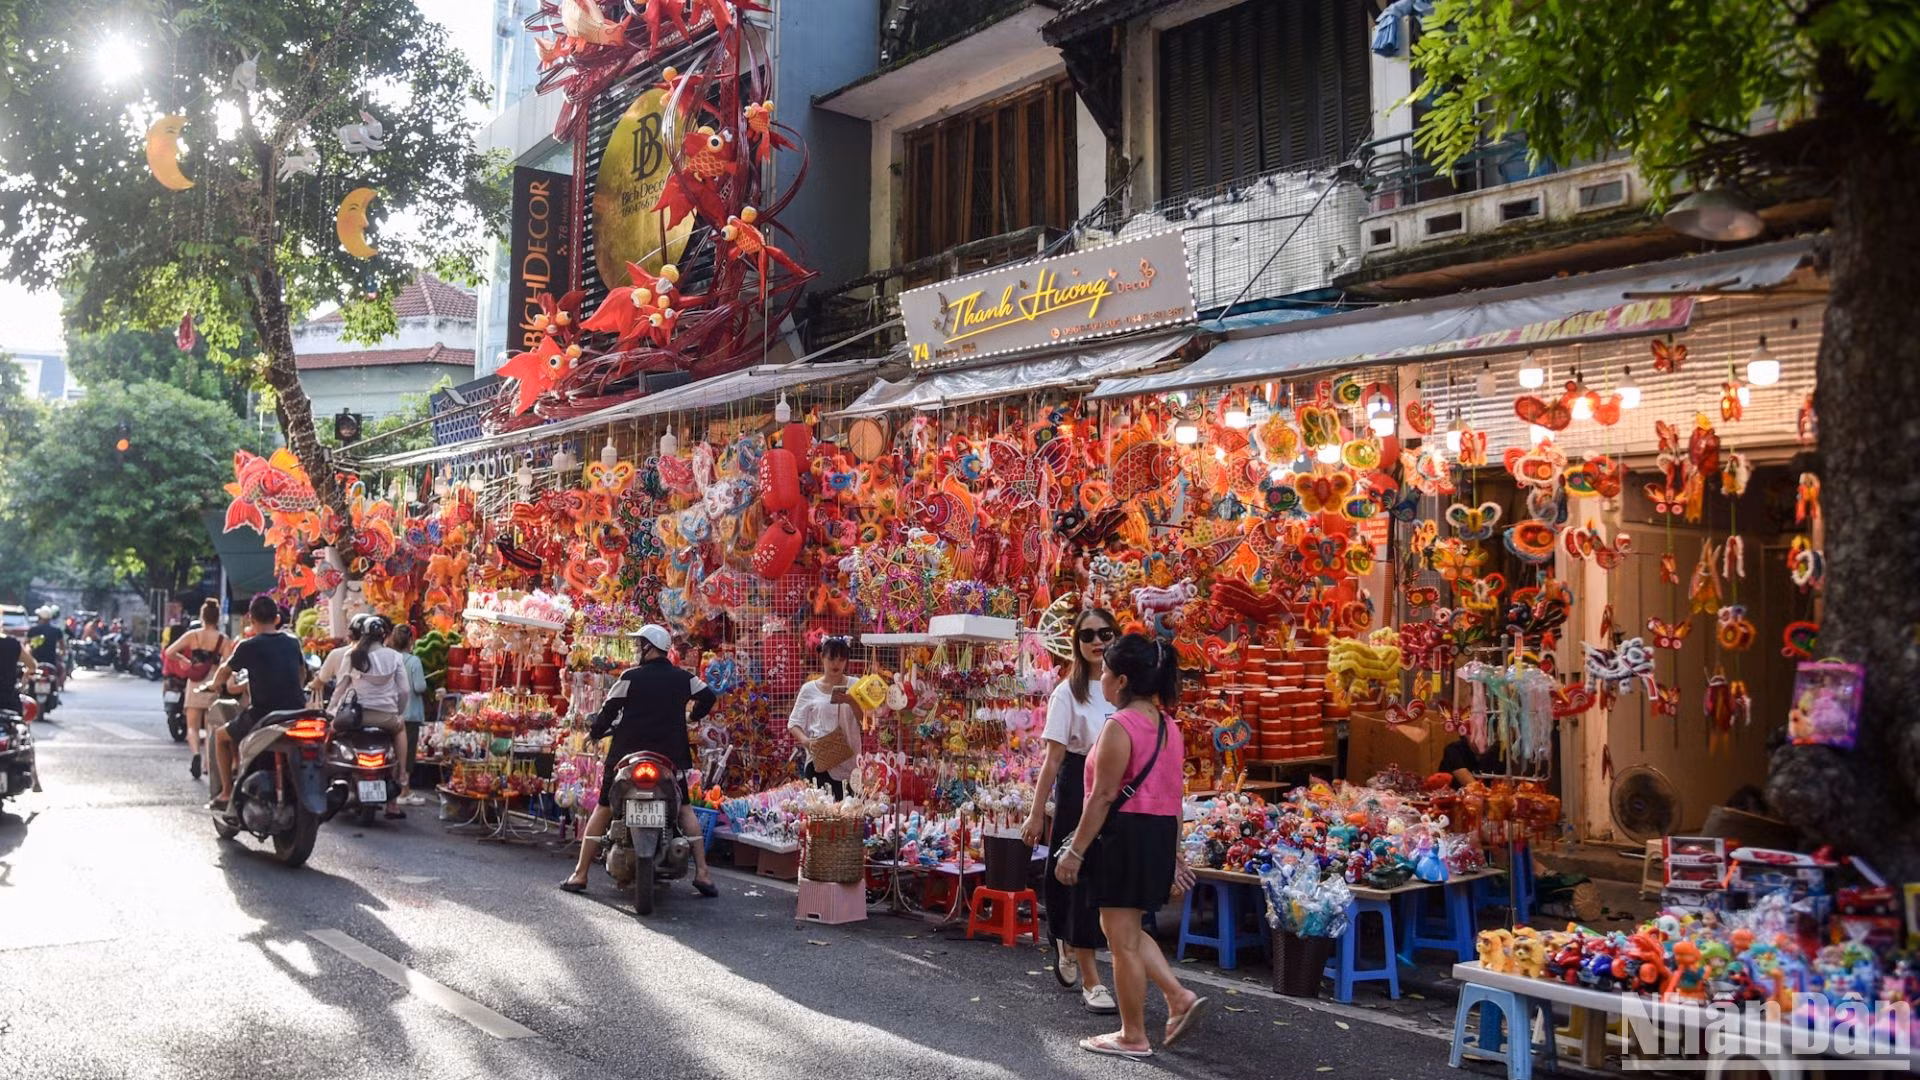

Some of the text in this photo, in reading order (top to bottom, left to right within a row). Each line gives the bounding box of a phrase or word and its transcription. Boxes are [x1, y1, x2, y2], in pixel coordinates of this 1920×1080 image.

[948, 283, 1014, 334] Thanh
[1116, 279, 1152, 294] Decor
[913, 342, 930, 362] 74
[634, 803, 659, 814] 19-H1
